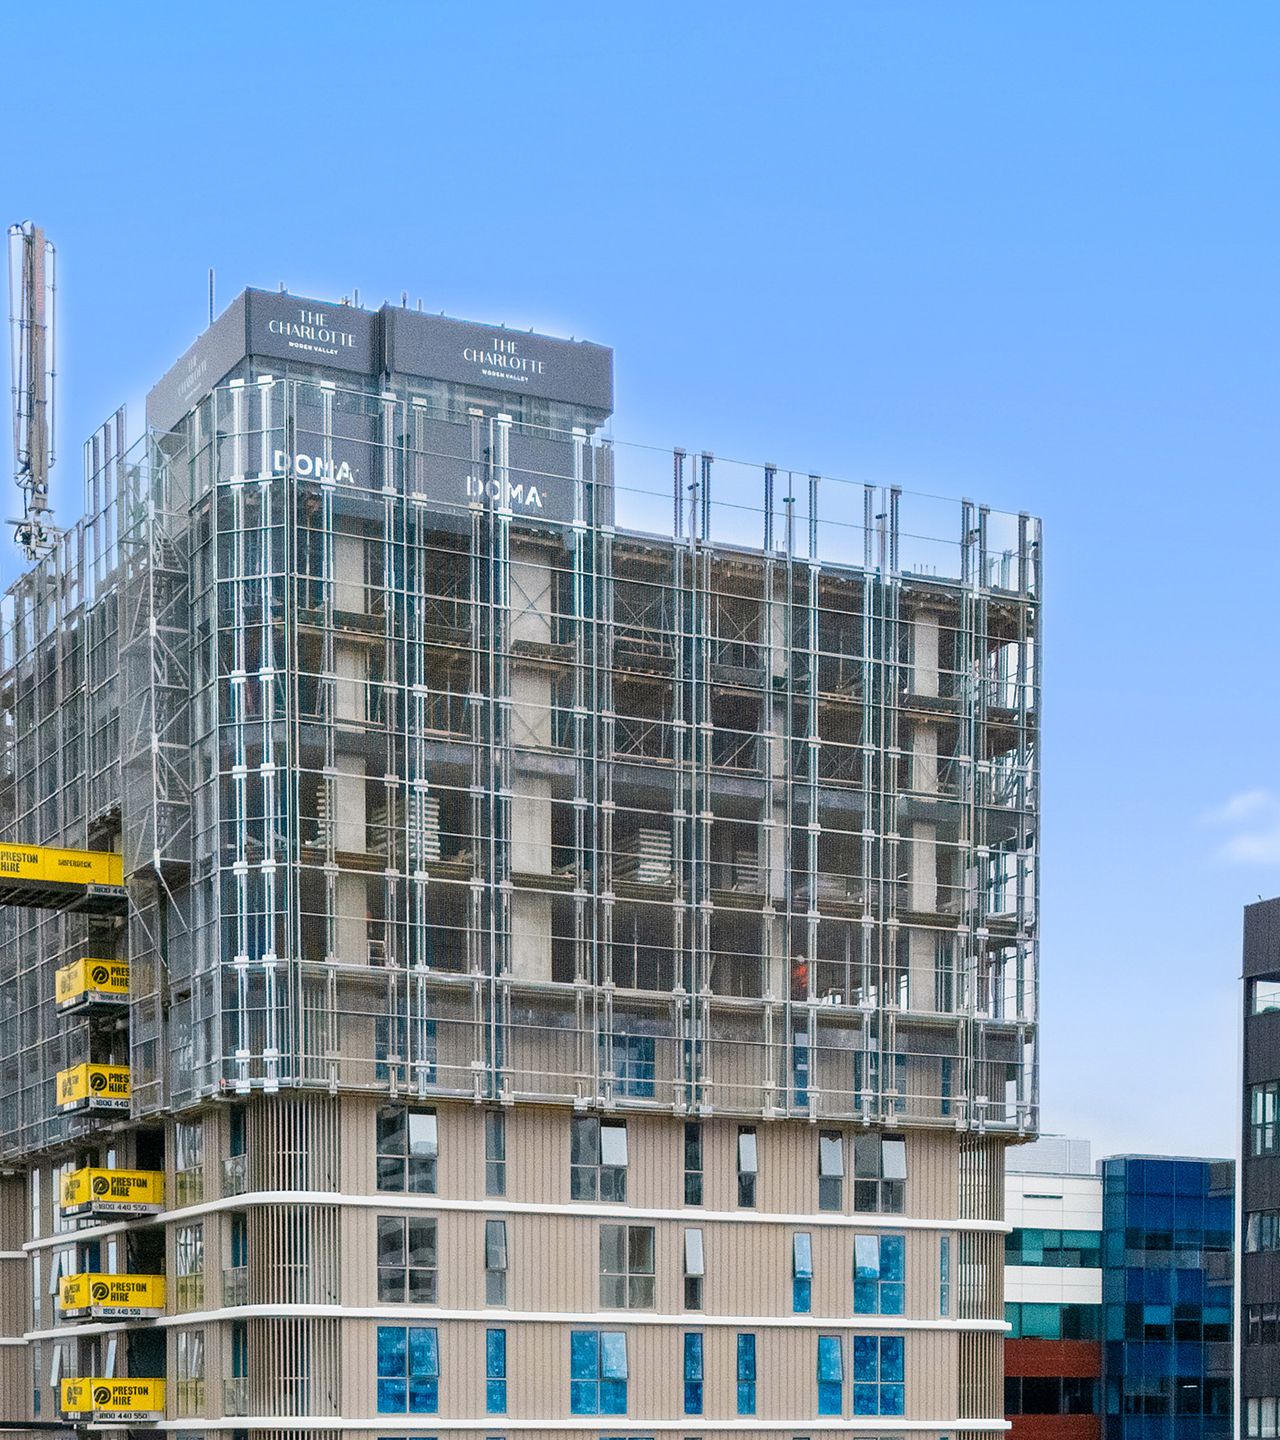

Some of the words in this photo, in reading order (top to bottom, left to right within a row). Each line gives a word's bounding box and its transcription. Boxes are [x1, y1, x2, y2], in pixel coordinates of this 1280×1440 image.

[298, 309, 329, 327] THE
[268, 319, 358, 349] CHARLOTTE
[288, 341, 312, 351] WODEN
[308, 346, 339, 356] VALLEY
[492, 337, 520, 355] THE
[463, 347, 546, 375] CHARLOTTE
[506, 373, 529, 383] VALLEY
[0, 850, 39, 864] PRESTON
[0, 862, 21, 873] HIRE
[110, 966, 130, 977] PRES
[110, 976, 130, 987] HIRE
[108, 1072, 130, 1084] PRES
[108, 1083, 128, 1093] HIRE
[111, 1176, 148, 1188] PRESTON
[111, 1186, 130, 1197] HIRE
[110, 1281, 147, 1293] PRESTON
[110, 1292, 130, 1302] HIRE
[112, 1386, 149, 1396] PRESTON
[112, 1395, 132, 1406] HIRE
